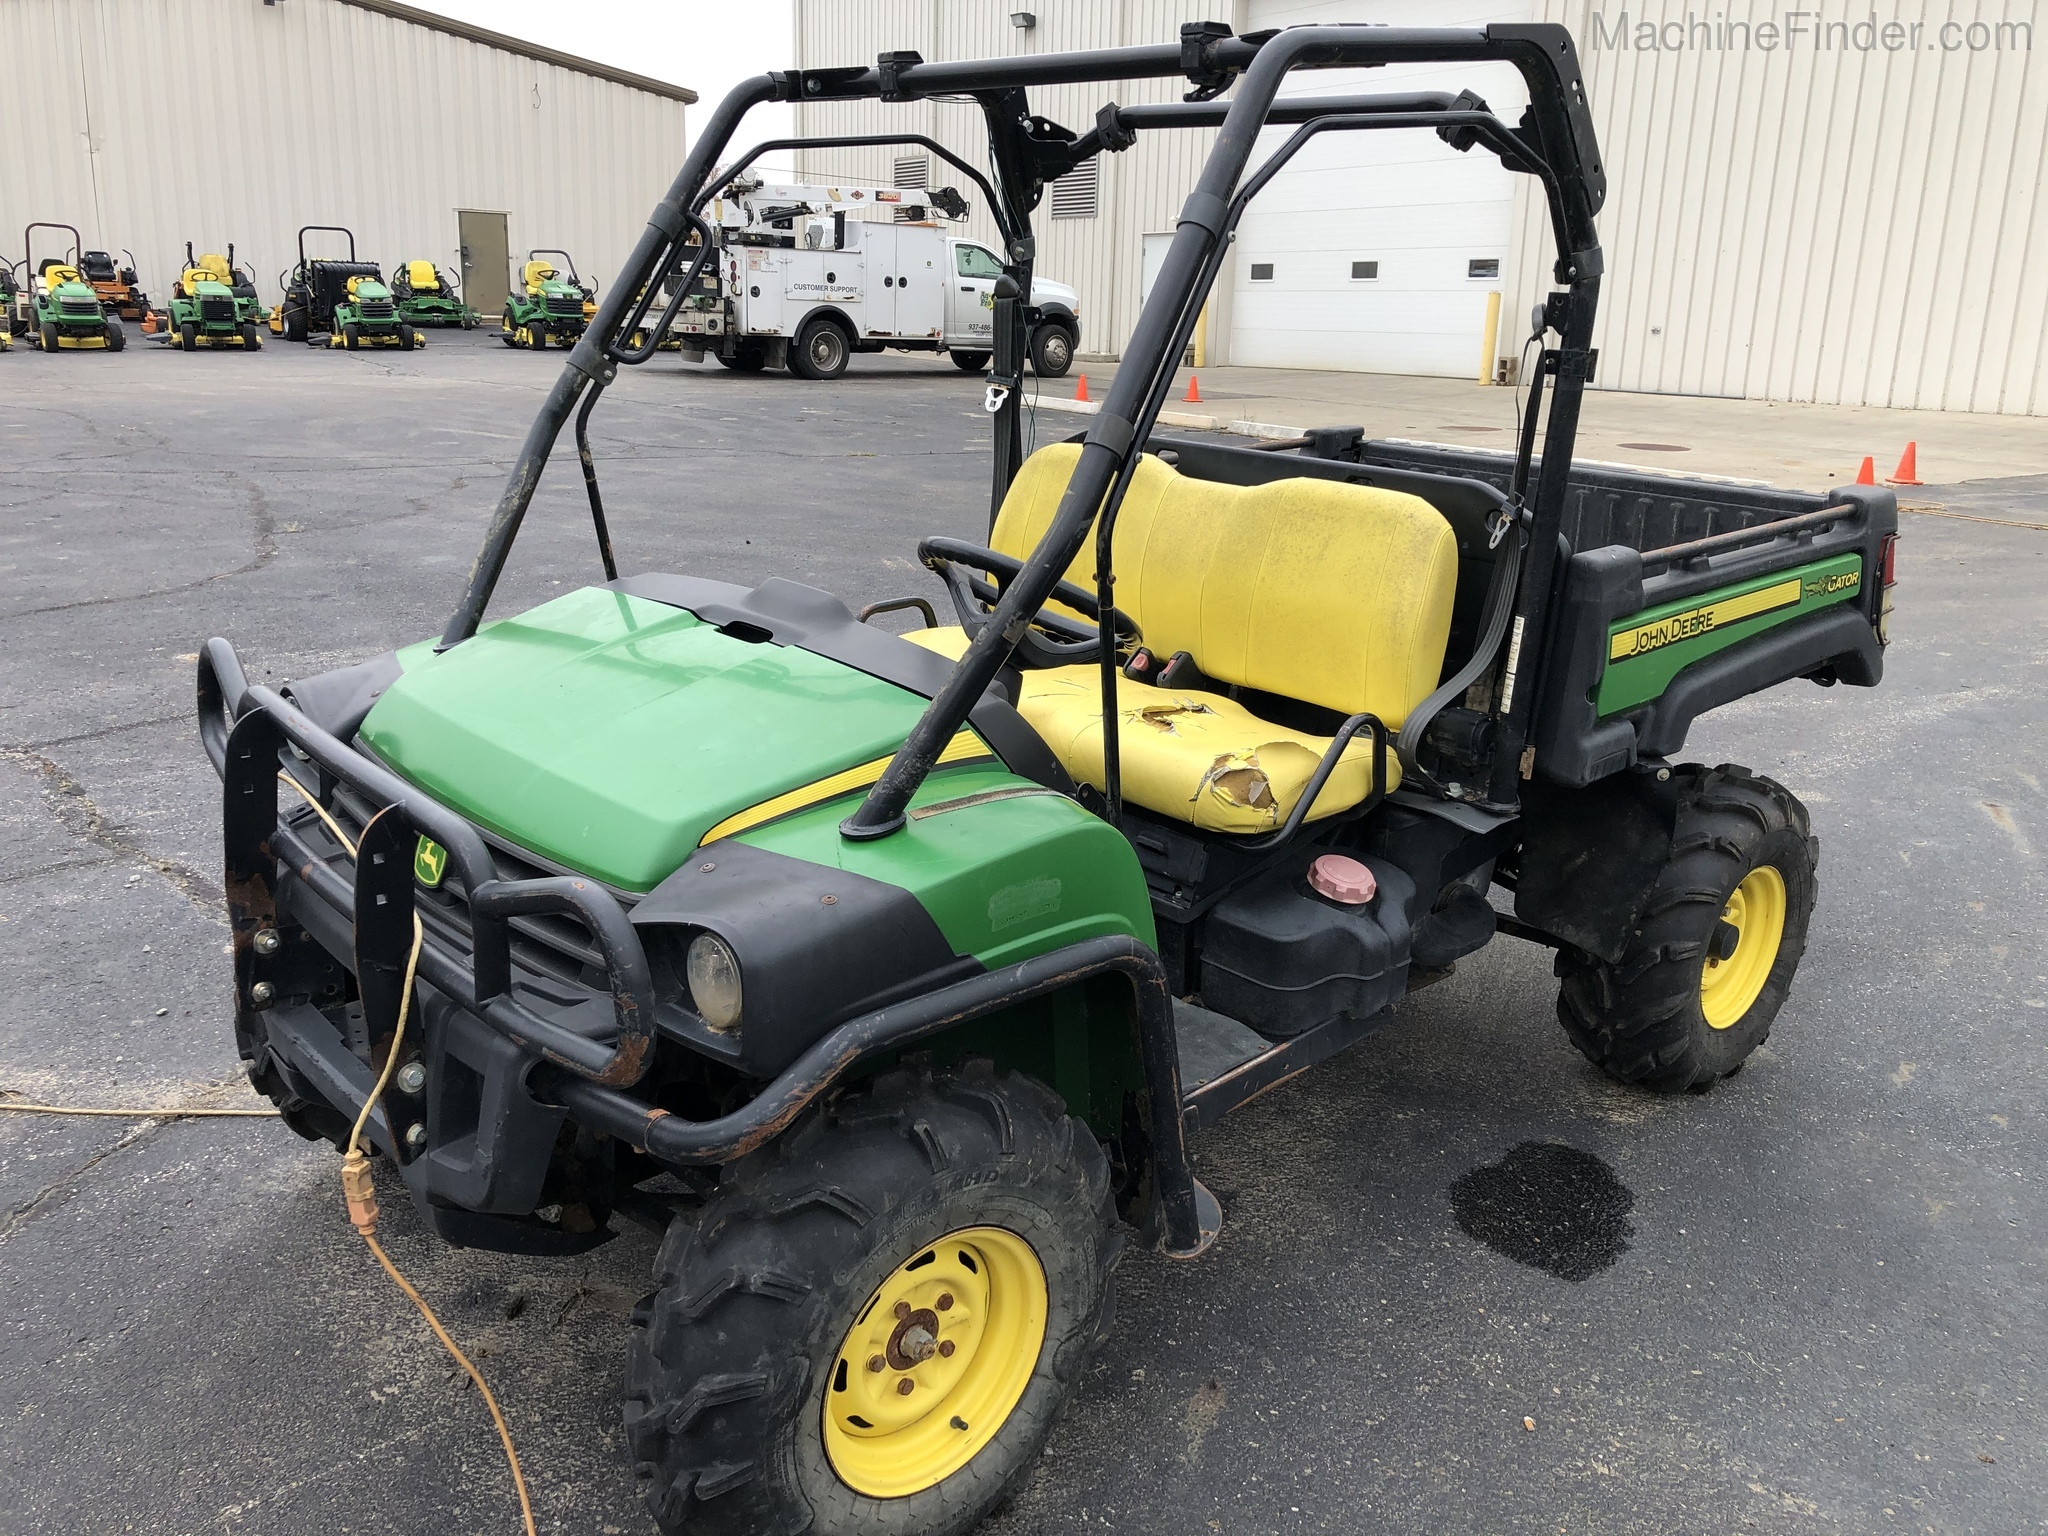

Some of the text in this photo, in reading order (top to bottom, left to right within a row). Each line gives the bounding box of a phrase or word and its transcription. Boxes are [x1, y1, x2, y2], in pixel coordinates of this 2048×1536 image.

[793, 283, 858, 293] CUSTOMER SUPPORT
[1827, 571, 1859, 593] GATOR
[1631, 611, 1715, 654] JOHN DEERE
[886, 1206, 938, 1248] CONDITIONS
